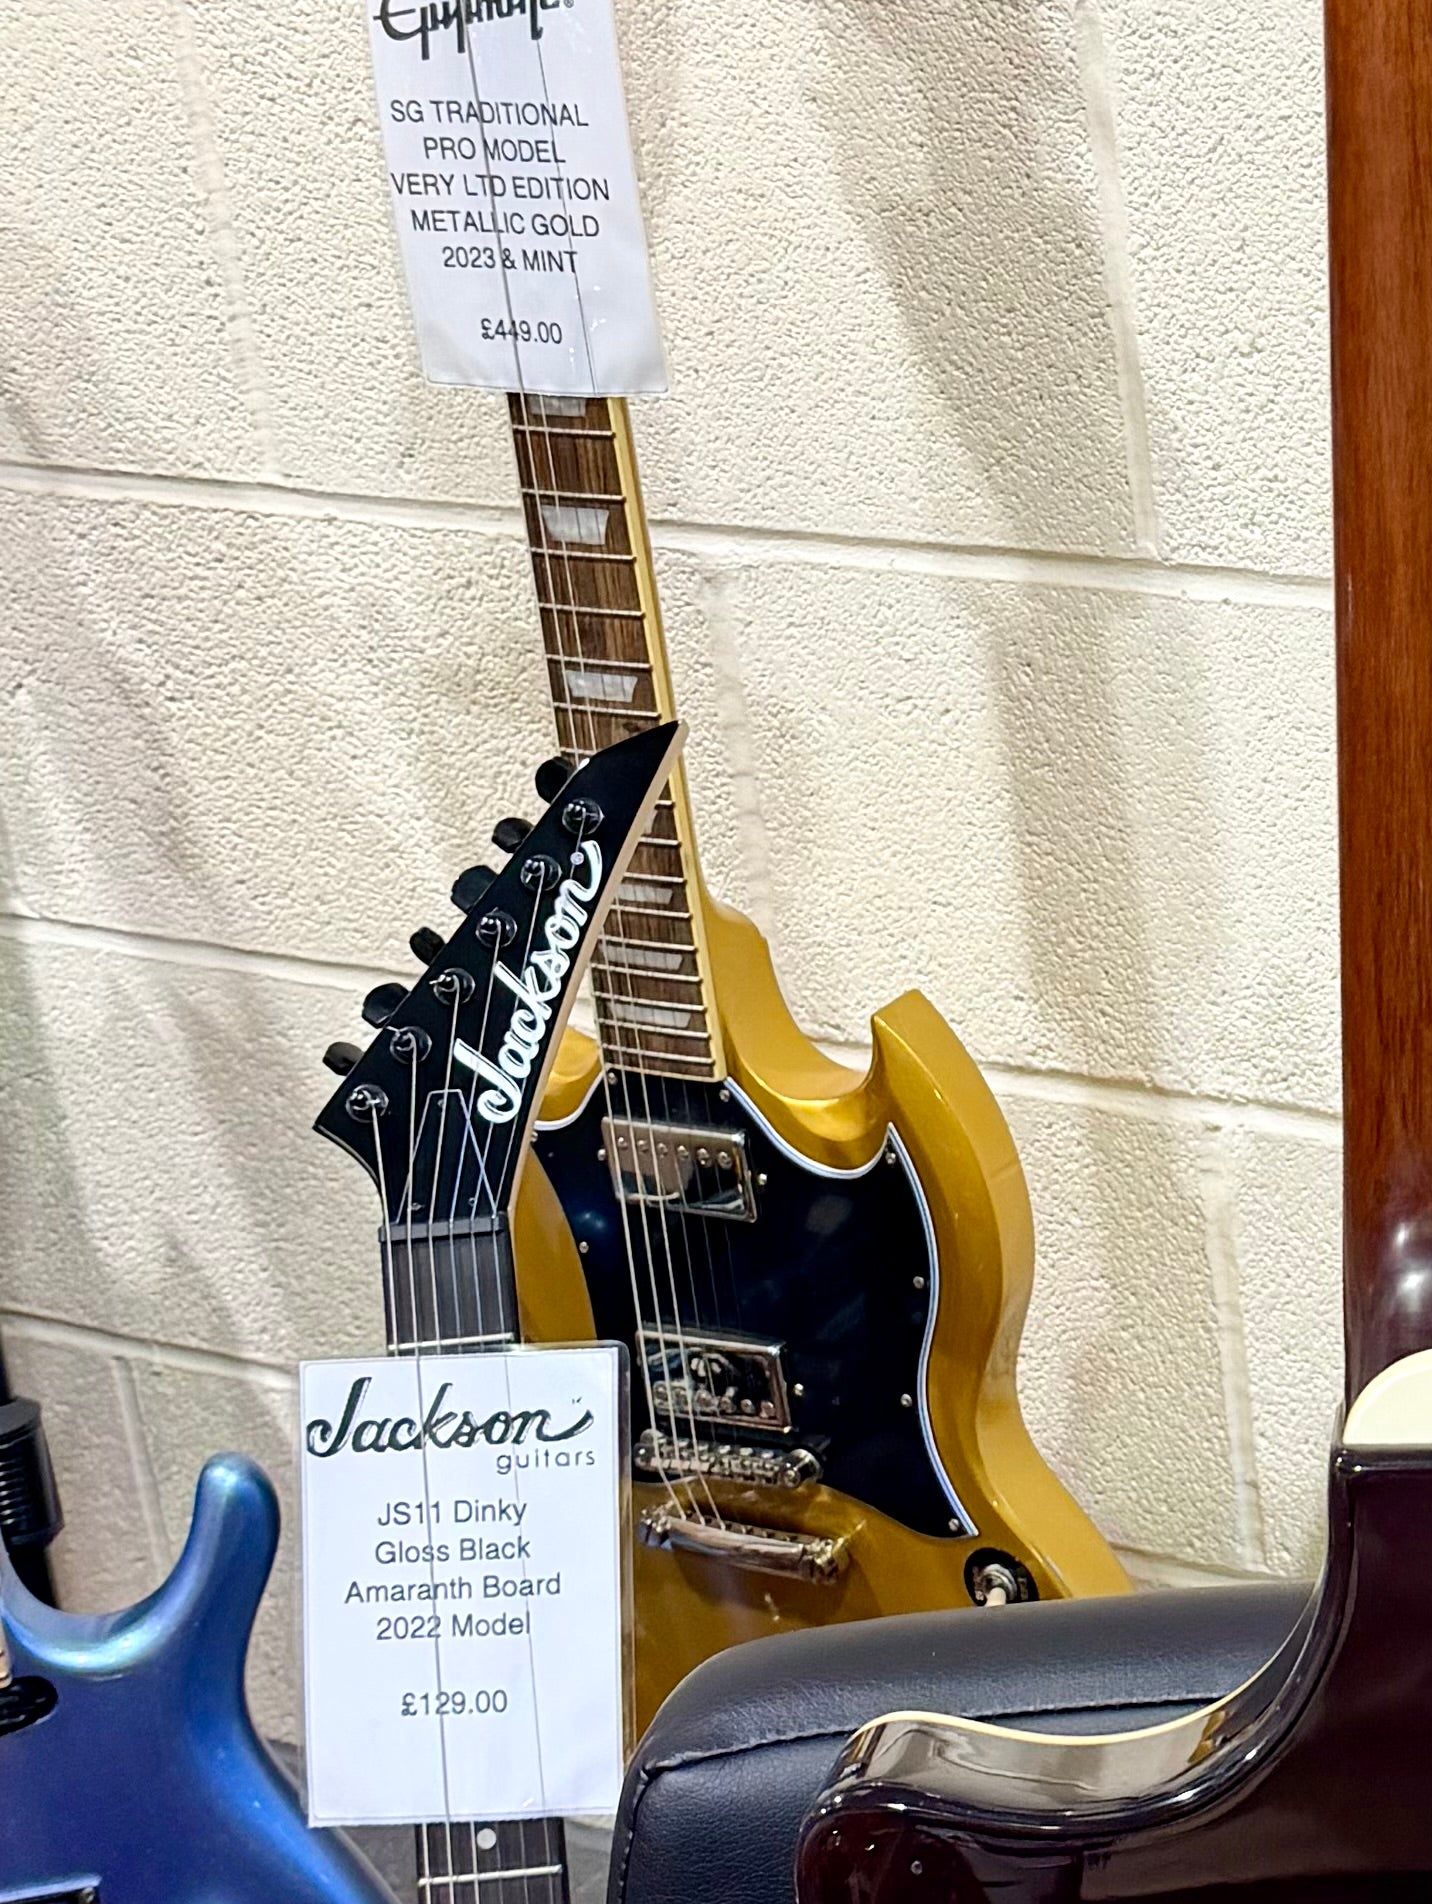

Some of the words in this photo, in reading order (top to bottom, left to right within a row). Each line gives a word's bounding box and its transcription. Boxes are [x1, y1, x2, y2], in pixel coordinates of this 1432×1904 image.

[391, 100, 424, 124] SG
[430, 101, 589, 127] TRADITIONAL
[424, 137, 476, 161] PRO
[484, 139, 566, 163] MODEL
[391, 173, 454, 196] VERY
[463, 175, 506, 197] LTD
[514, 177, 610, 201] EDITION
[411, 210, 525, 235] METALLIC
[531, 214, 600, 237] GOLD
[442, 246, 496, 269] 2023
[502, 249, 516, 270] &
[523, 250, 578, 274] MINT
[481, 318, 563, 345] £449.00
[454, 840, 603, 1124] Jackson
[306, 1377, 594, 1458] Jackson
[495, 1448, 596, 1475] guitars
[377, 1501, 442, 1526] JS11
[454, 1498, 528, 1527] Dinky
[374, 1539, 450, 1564] Gloss
[459, 1536, 531, 1561] Black
[345, 1576, 473, 1604] Amaranth
[482, 1572, 562, 1598] Board
[376, 1615, 442, 1641] 2022
[451, 1611, 530, 1638] Model
[400, 1688, 508, 1717] £129.00
